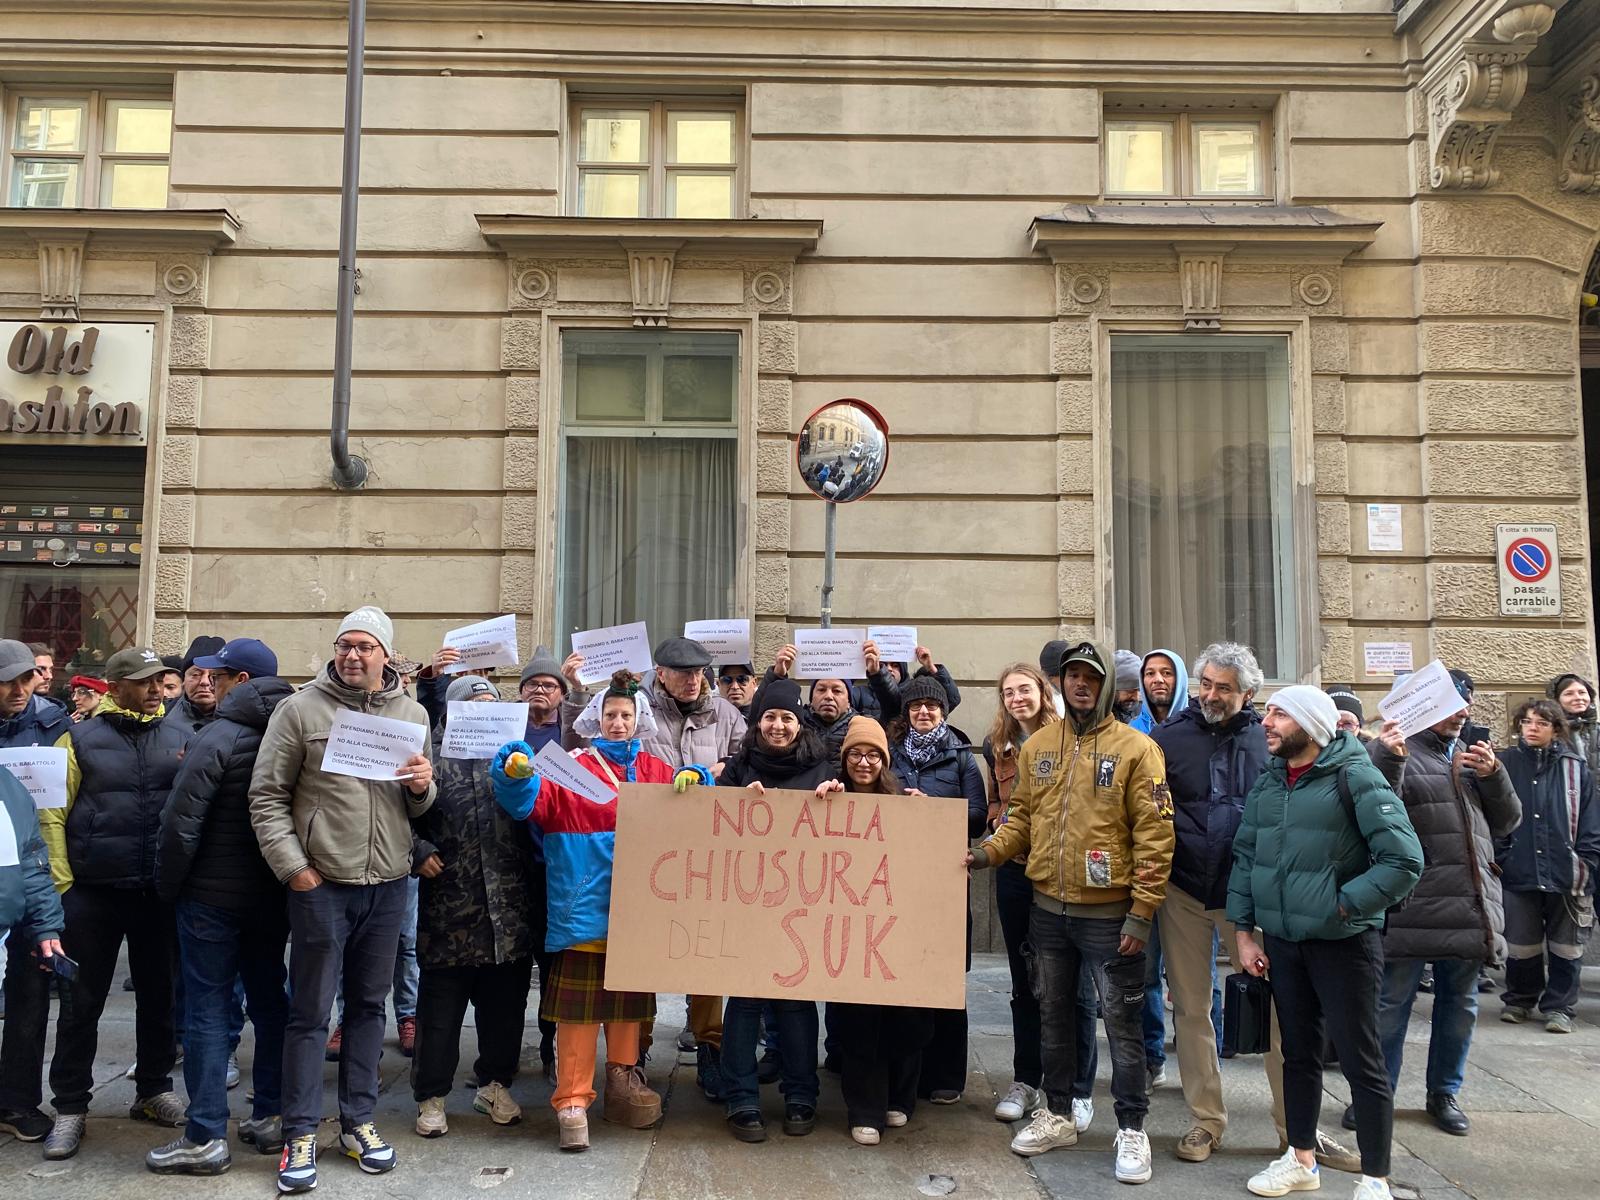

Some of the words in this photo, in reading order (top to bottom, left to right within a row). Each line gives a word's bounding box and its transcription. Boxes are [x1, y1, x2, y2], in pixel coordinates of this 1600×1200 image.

[7, 324, 100, 374] Old
[1506, 597, 1556, 606] carrabile
[340, 724, 374, 735] DIFENDIAMO
[381, 732, 414, 742] BARATTOLO
[362, 742, 390, 752] CHIUSURA
[334, 752, 354, 760] GIUNTA
[371, 758, 395, 767] RAZZISTI
[713, 799, 774, 838] NO
[792, 800, 885, 842] ALLA
[650, 850, 893, 908] CHIUSURA
[668, 919, 739, 959] DEL
[772, 908, 898, 988] SUK
